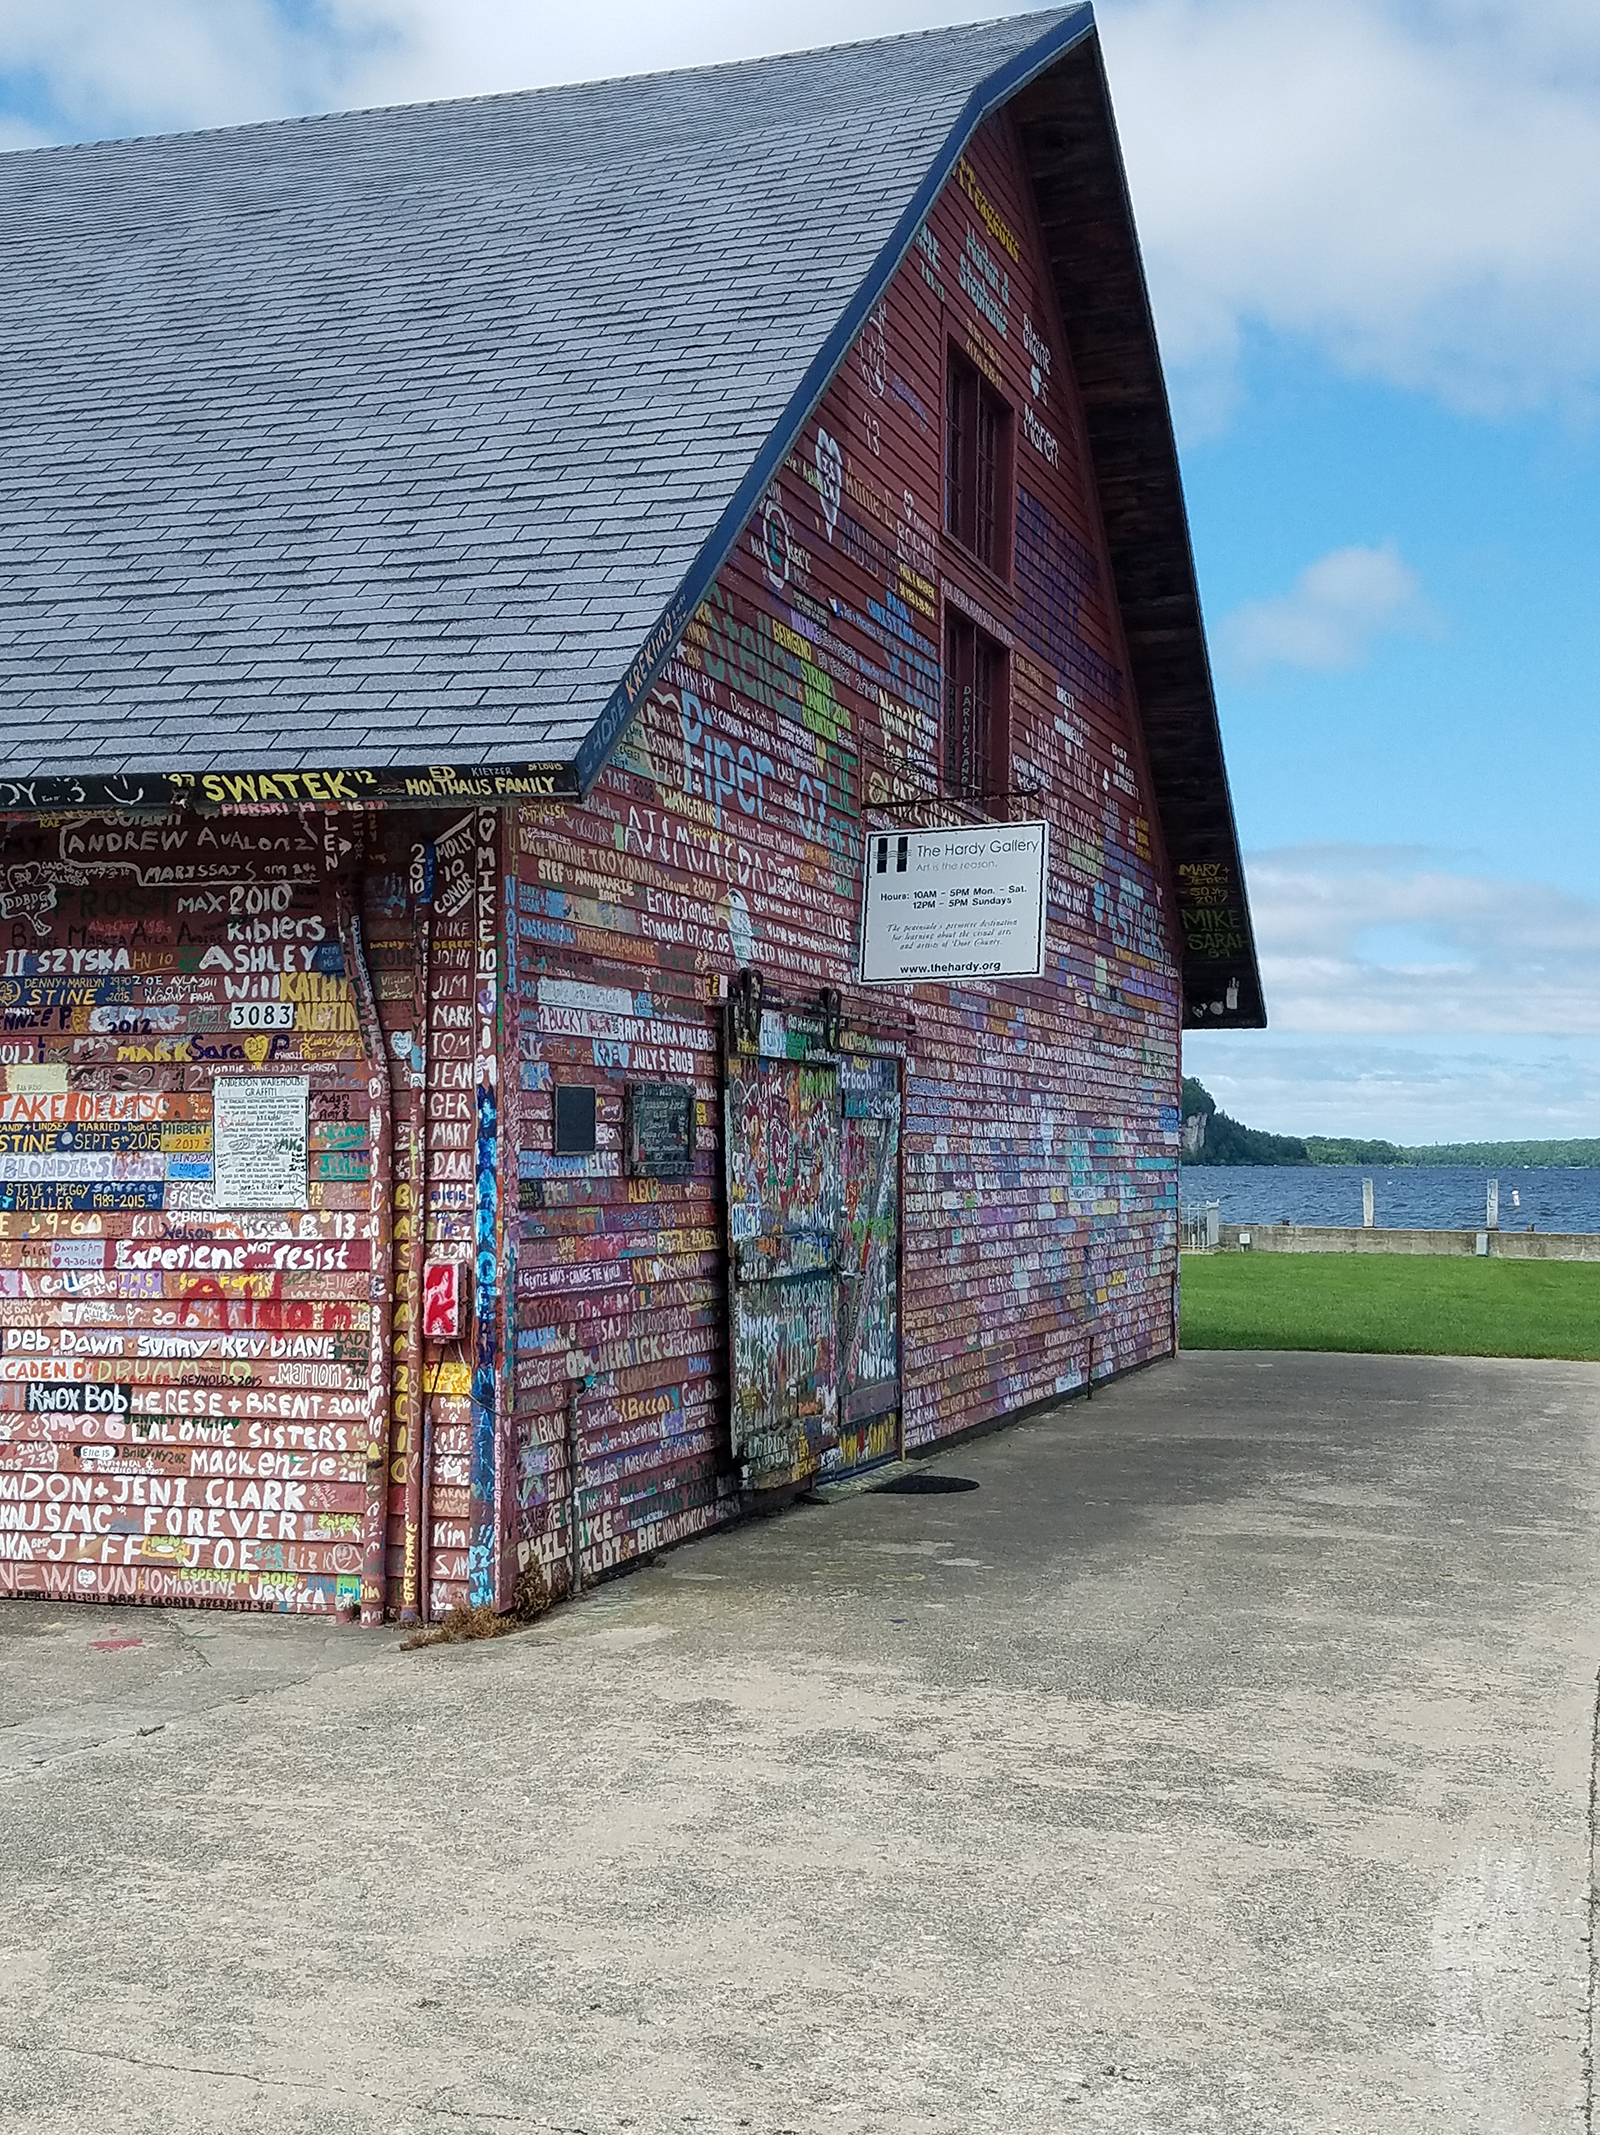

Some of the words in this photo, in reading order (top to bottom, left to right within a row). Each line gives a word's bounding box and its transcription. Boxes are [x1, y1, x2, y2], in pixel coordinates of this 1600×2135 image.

[429, 766, 456, 780] ED
[202, 771, 358, 803] SWATEK
[405, 779, 490, 797] HOLTHAUS
[495, 776, 555, 795] FAMILY
[67, 829, 189, 853] ANDREW
[435, 827, 476, 863] MOLLY
[917, 844, 941, 858] The
[945, 841, 987, 857] Hardy
[989, 839, 1040, 854] Gallery
[916, 863, 930, 872] Art
[942, 861, 958, 871] the
[960, 860, 998, 871] reason.
[177, 891, 228, 914] MAX
[228, 882, 294, 914] 2010
[433, 872, 475, 914] CONOR
[880, 892, 910, 902] Hours:
[913, 890, 937, 900] 10AM
[949, 888, 970, 898] 5PM
[973, 886, 996, 896] Mon.
[1008, 885, 1028, 894] Sat.
[913, 900, 936, 910] 12PM
[948, 898, 969, 908] 5PM
[972, 896, 1013, 907] Sundays
[641, 912, 684, 942] Engaged
[1181, 909, 1240, 930] MIKE
[199, 943, 319, 974] ASHLEY
[432, 949, 471, 968] JOHN
[899, 961, 1002, 975] www.thehardy.org
[26, 988, 98, 1006] STINE
[224, 975, 280, 1000] Will
[432, 974, 467, 1000] JIM
[107, 1017, 153, 1035] 2012
[233, 1006, 292, 1026] 3083
[432, 1004, 473, 1028] MARK
[190, 1033, 246, 1060] Sara
[430, 1032, 471, 1056] TOM
[301, 1062, 338, 1073] CHRISTA
[632, 1046, 657, 1071] JULY
[217, 1078, 258, 1087] ANDERSON
[260, 1077, 305, 1087] WAREHOUSE
[428, 1062, 474, 1088] JEAN
[244, 1088, 277, 1096] GRAFFITI
[430, 1092, 471, 1119] GER
[33, 1122, 69, 1132] LINDSEY
[77, 1122, 120, 1133] MARRIED
[162, 1122, 209, 1136] HIBBERT
[431, 1123, 472, 1149] MARY
[0, 1133, 58, 1151] STINE
[129, 1133, 161, 1151] 2015
[174, 1138, 200, 1150] 2017
[434, 1150, 472, 1177] DAN
[6, 1183, 47, 1196] STEVE
[56, 1184, 91, 1198] PEGGY
[15, 1196, 74, 1211] MILLER
[155, 1222, 214, 1241] Nelson
[246, 1241, 276, 1254] NOT
[272, 1240, 350, 1271] resist
[7, 1329, 51, 1351] Deb
[60, 1330, 124, 1355] Dawn
[137, 1335, 210, 1359] Sunny
[688, 1356, 712, 1375] DAVIS
[180, 1373, 235, 1387] REYNOLDS
[84, 1385, 129, 1413] Bob
[112, 1475, 188, 1507] JENI
[205, 1477, 307, 1511] CLARK
[432, 1487, 471, 1499] SARAH
[25, 1502, 113, 1533] USMC
[143, 1506, 299, 1541] FOREVER
[433, 1521, 467, 1548] Kim
[46, 1532, 145, 1565] JEFF
[182, 1537, 262, 1570] JOE
[180, 1567, 250, 1584] ESPESETH
[261, 1572, 297, 1587] 2015
